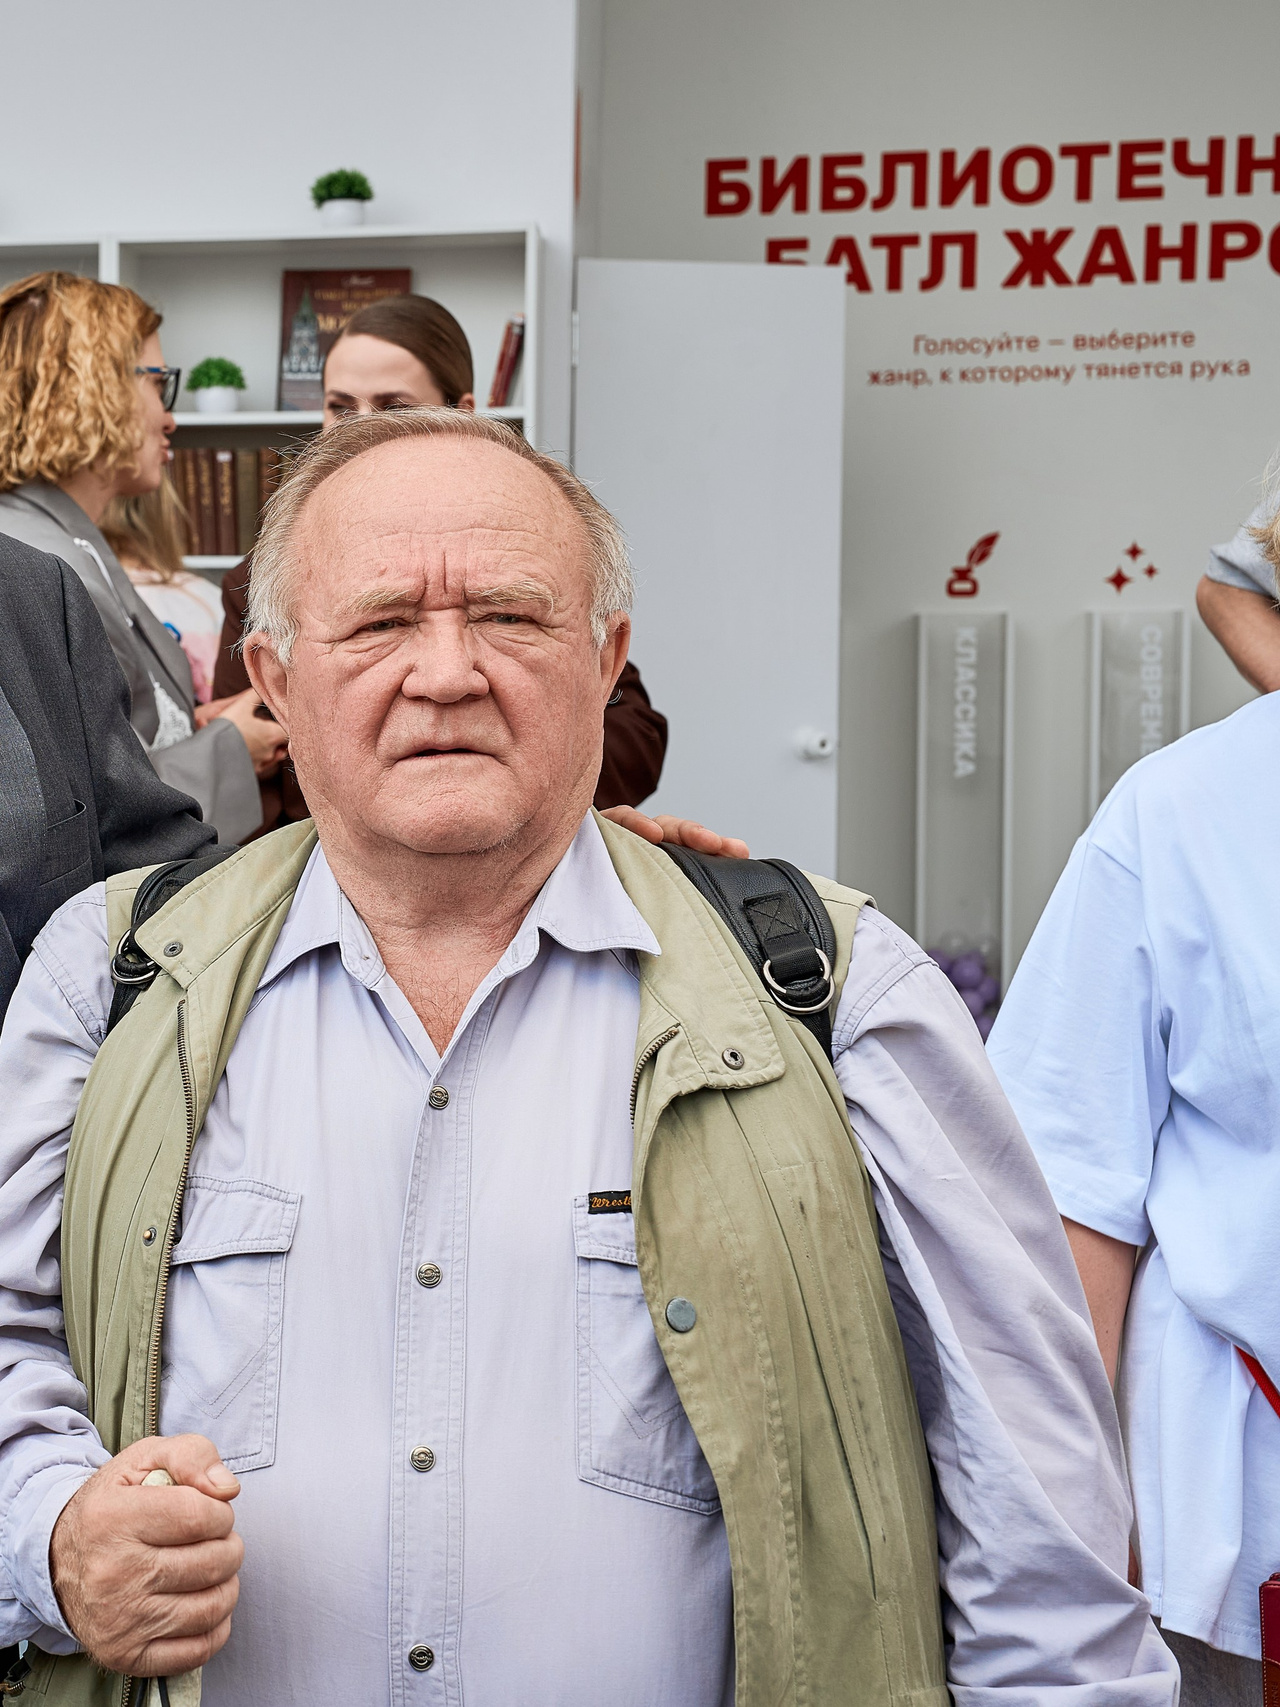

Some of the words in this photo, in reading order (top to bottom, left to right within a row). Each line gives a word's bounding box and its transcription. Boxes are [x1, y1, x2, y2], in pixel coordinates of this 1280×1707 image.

[704, 134, 1280, 217] БИБЛИОТЕЧН
[1001, 220, 1280, 289] ЖАНР
[867, 367, 933, 388] жанр,
[939, 368, 953, 383] к
[959, 363, 1077, 387] которому
[1083, 360, 1183, 380] тянется
[1189, 358, 1251, 382] рука
[913, 331, 1041, 357] Голосуйте
[1072, 328, 1196, 353] выберите
[954, 626, 977, 779] КЛАССИКА
